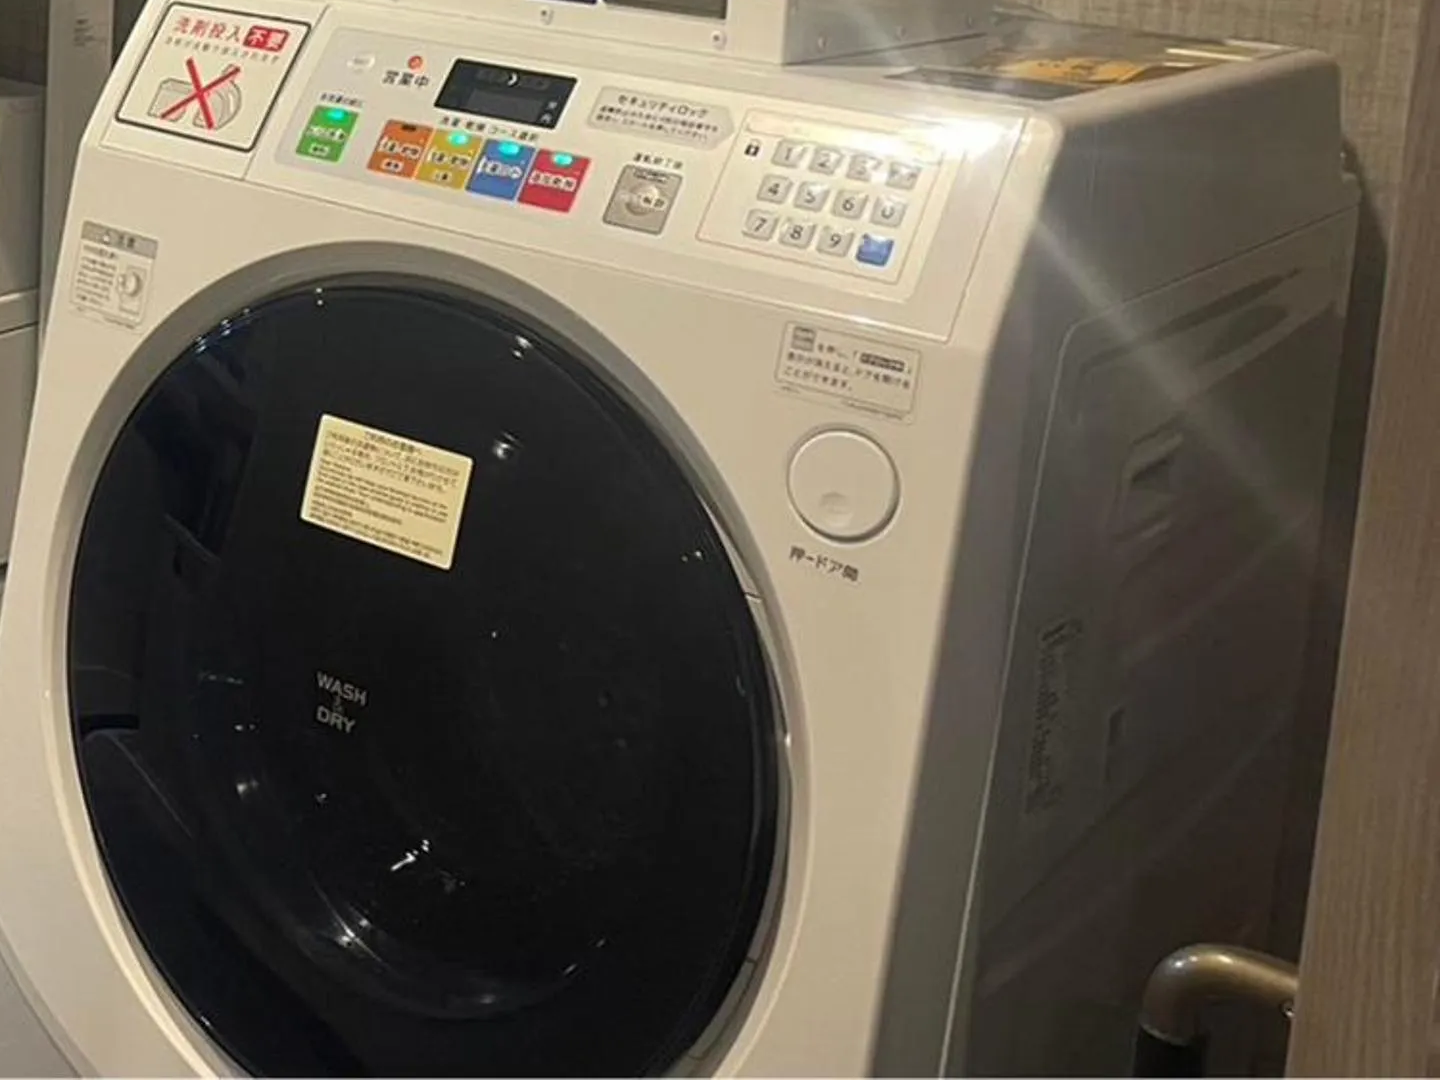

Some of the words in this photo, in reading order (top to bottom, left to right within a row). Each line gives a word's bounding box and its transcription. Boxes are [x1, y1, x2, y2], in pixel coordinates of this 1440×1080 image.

[818, 152, 831, 169] 2
[767, 183, 781, 196] 4
[841, 196, 855, 212] 6
[755, 217, 768, 232] 7
[789, 224, 804, 240] 8
[829, 233, 842, 248] 9
[316, 670, 368, 707] WASH
[316, 705, 357, 734] DRY
